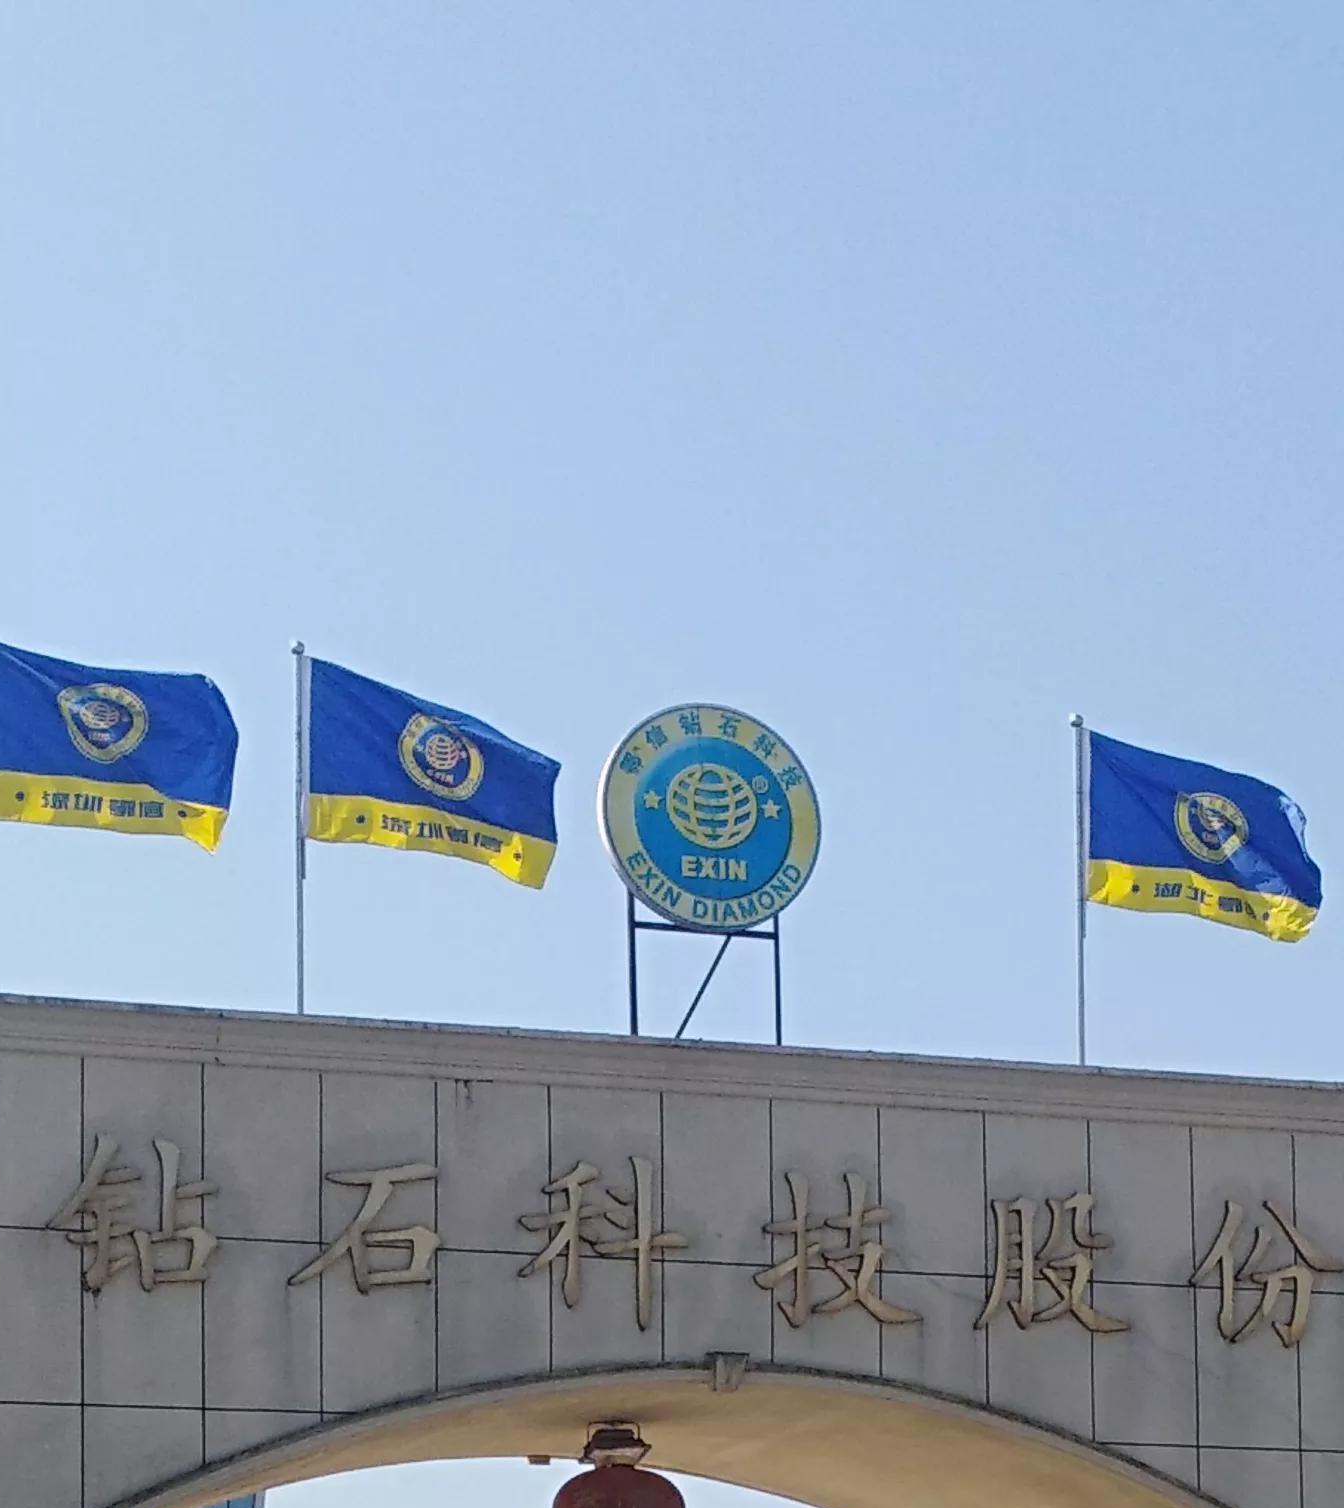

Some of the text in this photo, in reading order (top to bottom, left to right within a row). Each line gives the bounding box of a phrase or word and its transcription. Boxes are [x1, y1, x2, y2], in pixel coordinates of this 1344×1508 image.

[626, 850, 803, 922] EXIN DIAMOND
[679, 855, 749, 881] EXIN
